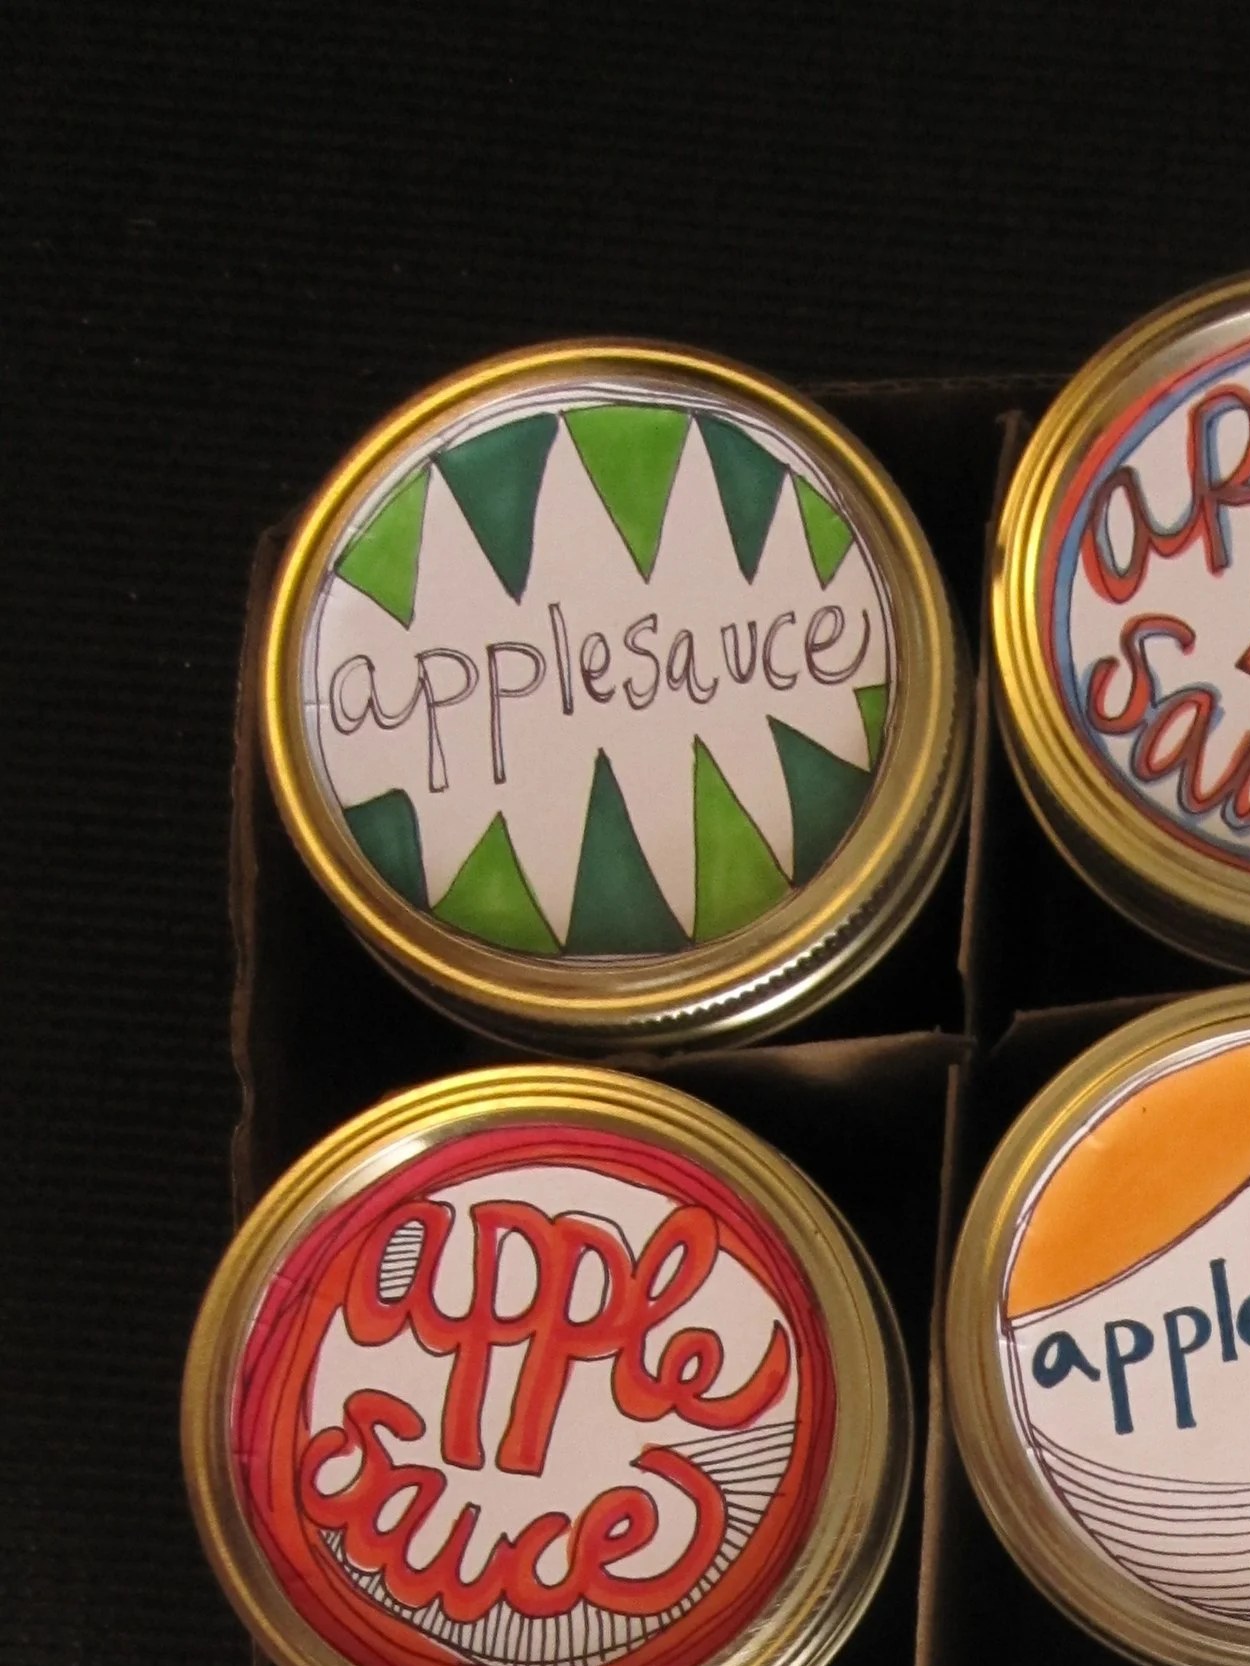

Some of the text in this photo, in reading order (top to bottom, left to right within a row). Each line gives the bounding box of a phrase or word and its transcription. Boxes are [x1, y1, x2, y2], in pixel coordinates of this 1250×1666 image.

[329, 602, 871, 793] applesauce
[342, 1199, 791, 1477] apple
[298, 1389, 727, 1624] sauce
